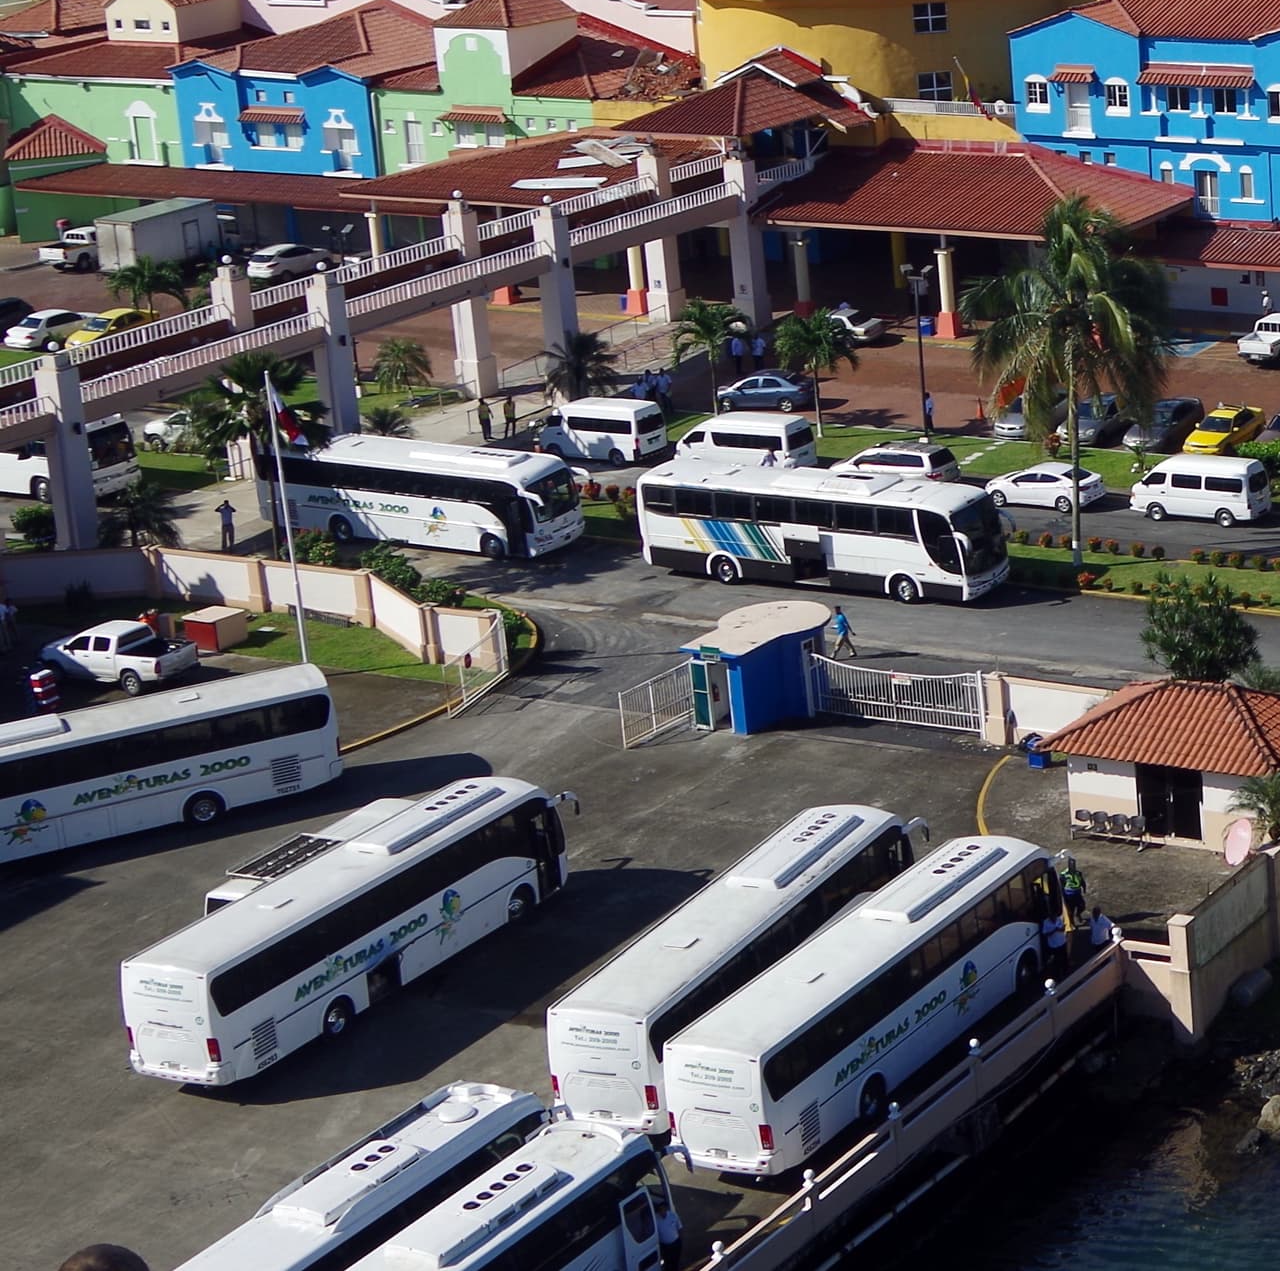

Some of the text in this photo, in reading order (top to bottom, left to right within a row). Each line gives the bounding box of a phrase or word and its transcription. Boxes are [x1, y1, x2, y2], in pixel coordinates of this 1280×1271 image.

[379, 502, 410, 514] 2000
[73, 755, 251, 806] AVENTURAS 2000
[294, 913, 428, 1002] AVENTURAS 2000
[914, 990, 947, 1024] 2000
